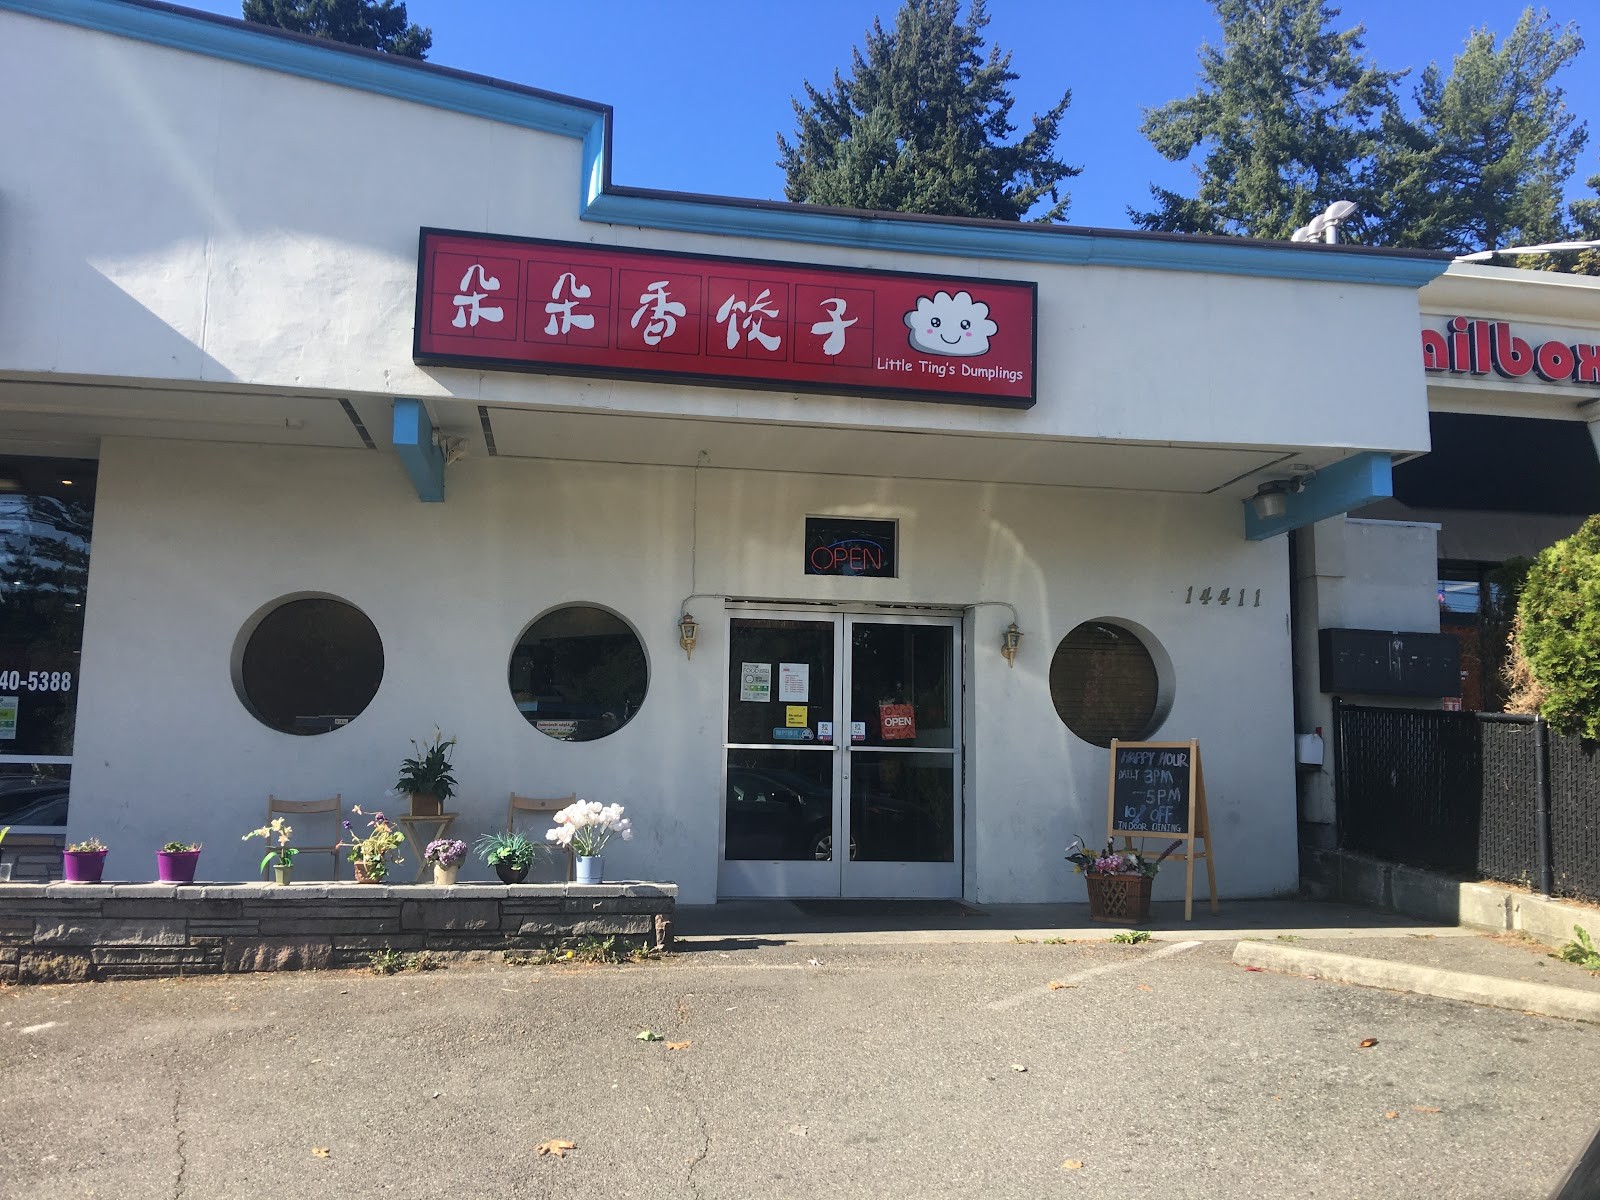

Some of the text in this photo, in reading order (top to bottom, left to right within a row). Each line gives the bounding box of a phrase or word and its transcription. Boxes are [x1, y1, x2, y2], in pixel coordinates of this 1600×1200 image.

[451, 263, 859, 357] 朵朵香饺子
[876, 356, 1024, 383] Little Ting's Dumplings
[811, 546, 881, 570] OPEN
[1185, 585, 1261, 608] 14411
[0, 670, 72, 692] 40-5388
[884, 717, 912, 727] OPEN
[1121, 751, 1189, 767] HAPPY HOUR
[1144, 769, 1174, 785] 3PM
[1150, 805, 1174, 824] OFF
[1118, 820, 1181, 832] INDOOR DINING
